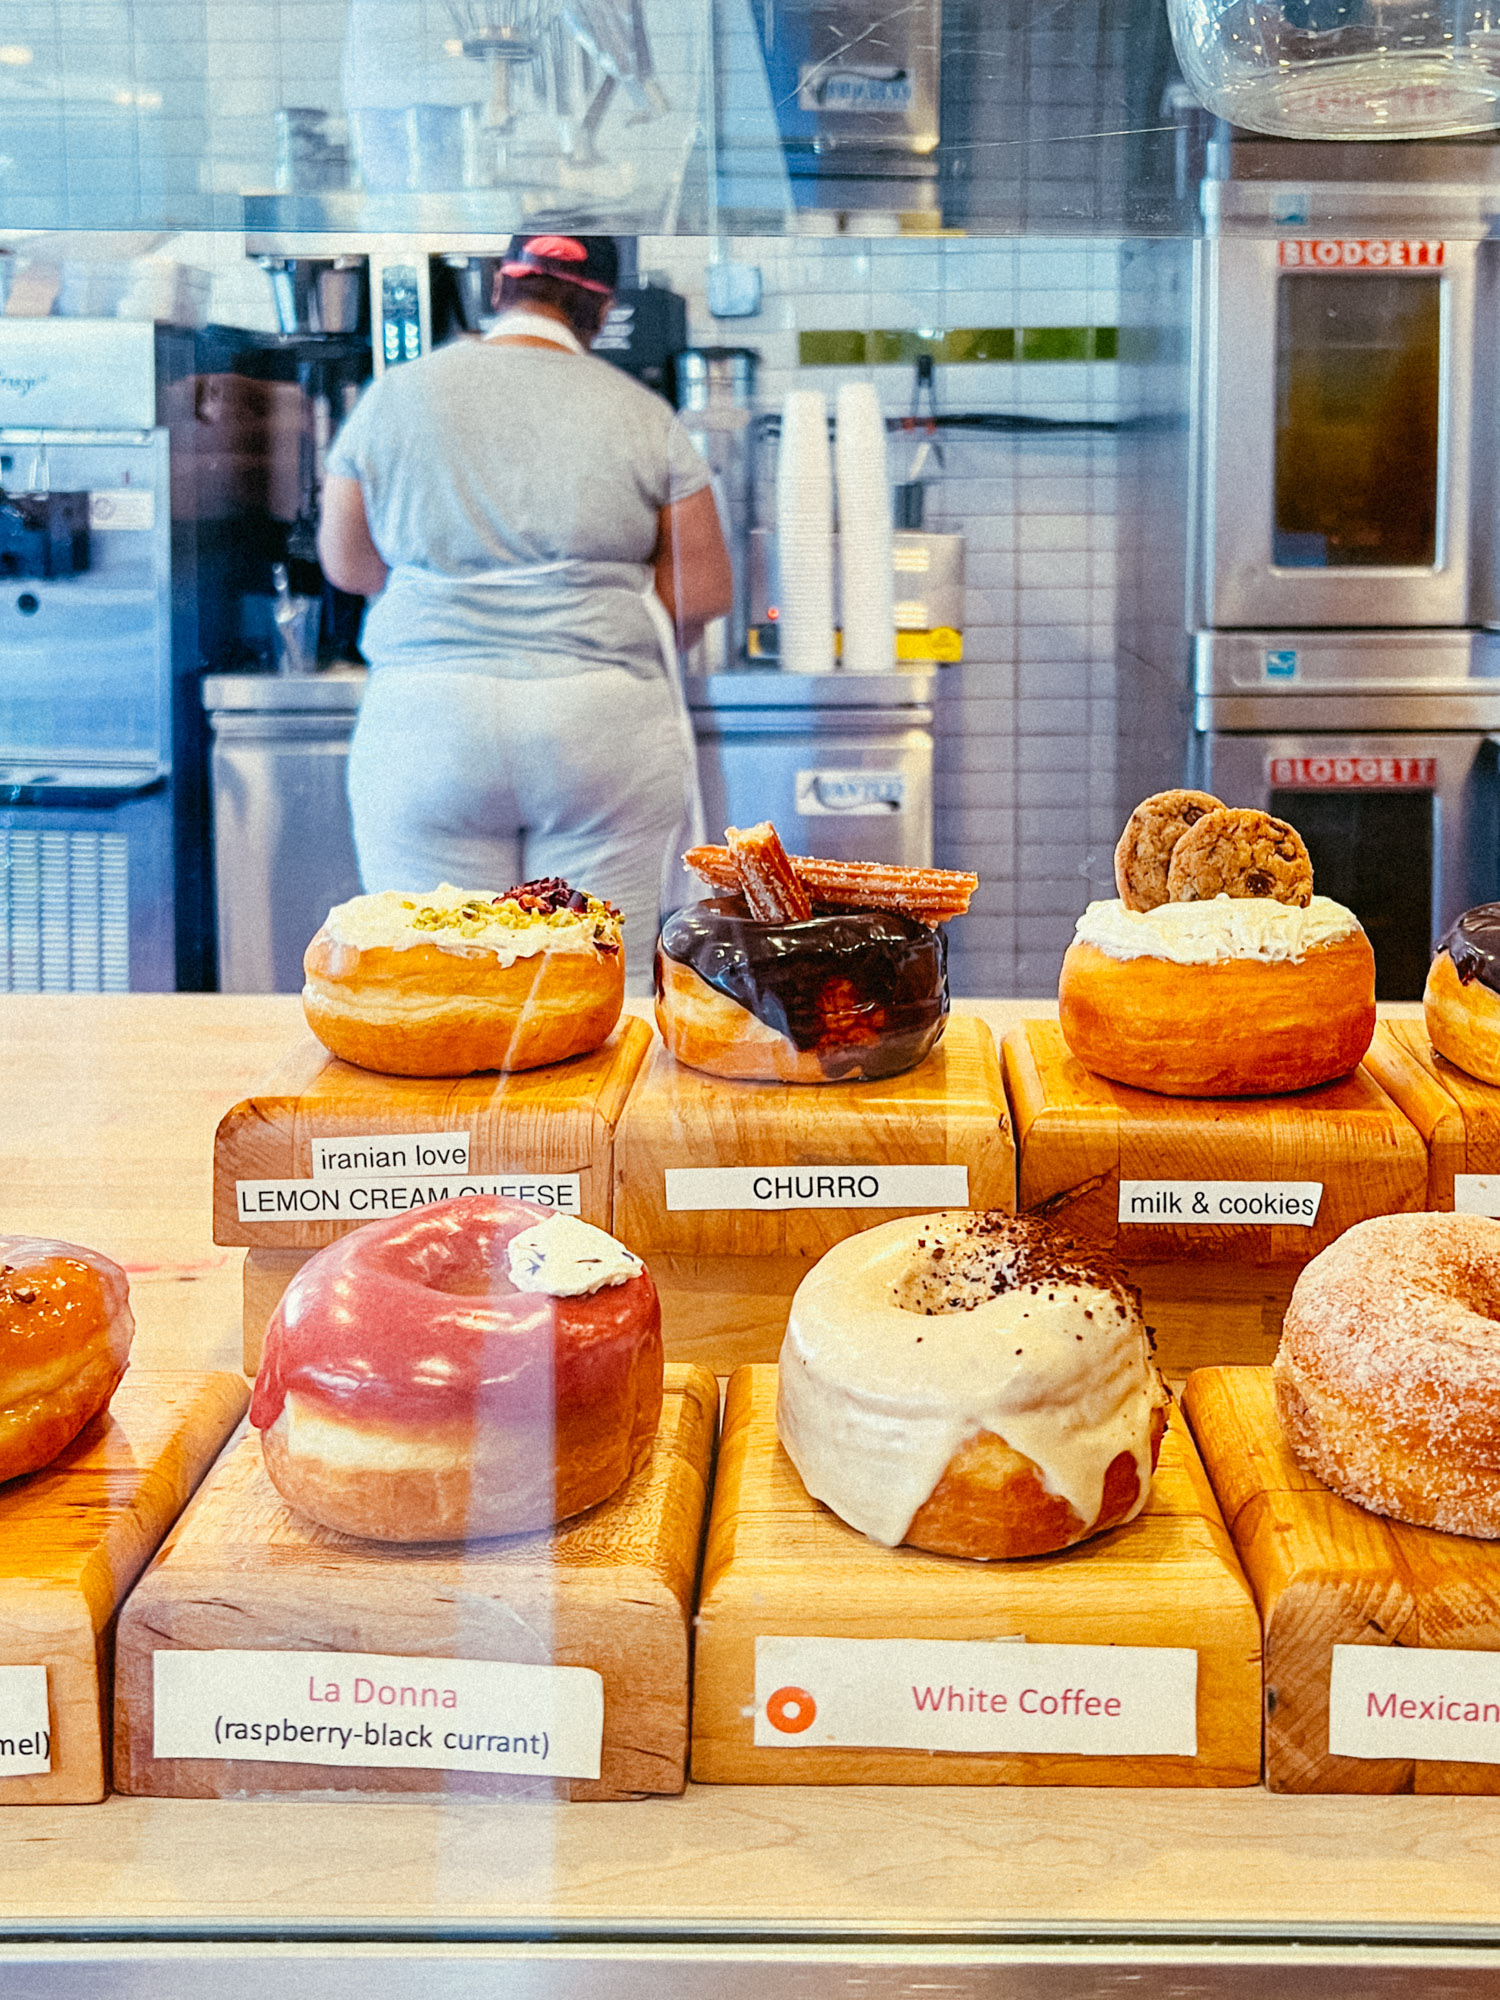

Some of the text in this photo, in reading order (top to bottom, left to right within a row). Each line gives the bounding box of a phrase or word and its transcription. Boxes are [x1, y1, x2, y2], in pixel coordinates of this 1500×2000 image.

[1283, 240, 1442, 266] BLODGETT
[1275, 758, 1435, 784] BLODGETT
[321, 1144, 467, 1170] iranian love
[242, 1189, 340, 1212] LEMON
[349, 1186, 449, 1211] CREAM
[752, 1175, 880, 1200] CHURRO
[1130, 1191, 1315, 1217] milk & cookies
[308, 1675, 458, 1709] La Donna
[911, 1684, 1122, 1717] White Coffee
[1366, 1692, 1500, 1723] Mexican
[214, 1715, 550, 1760] (raspberry-black currant)
